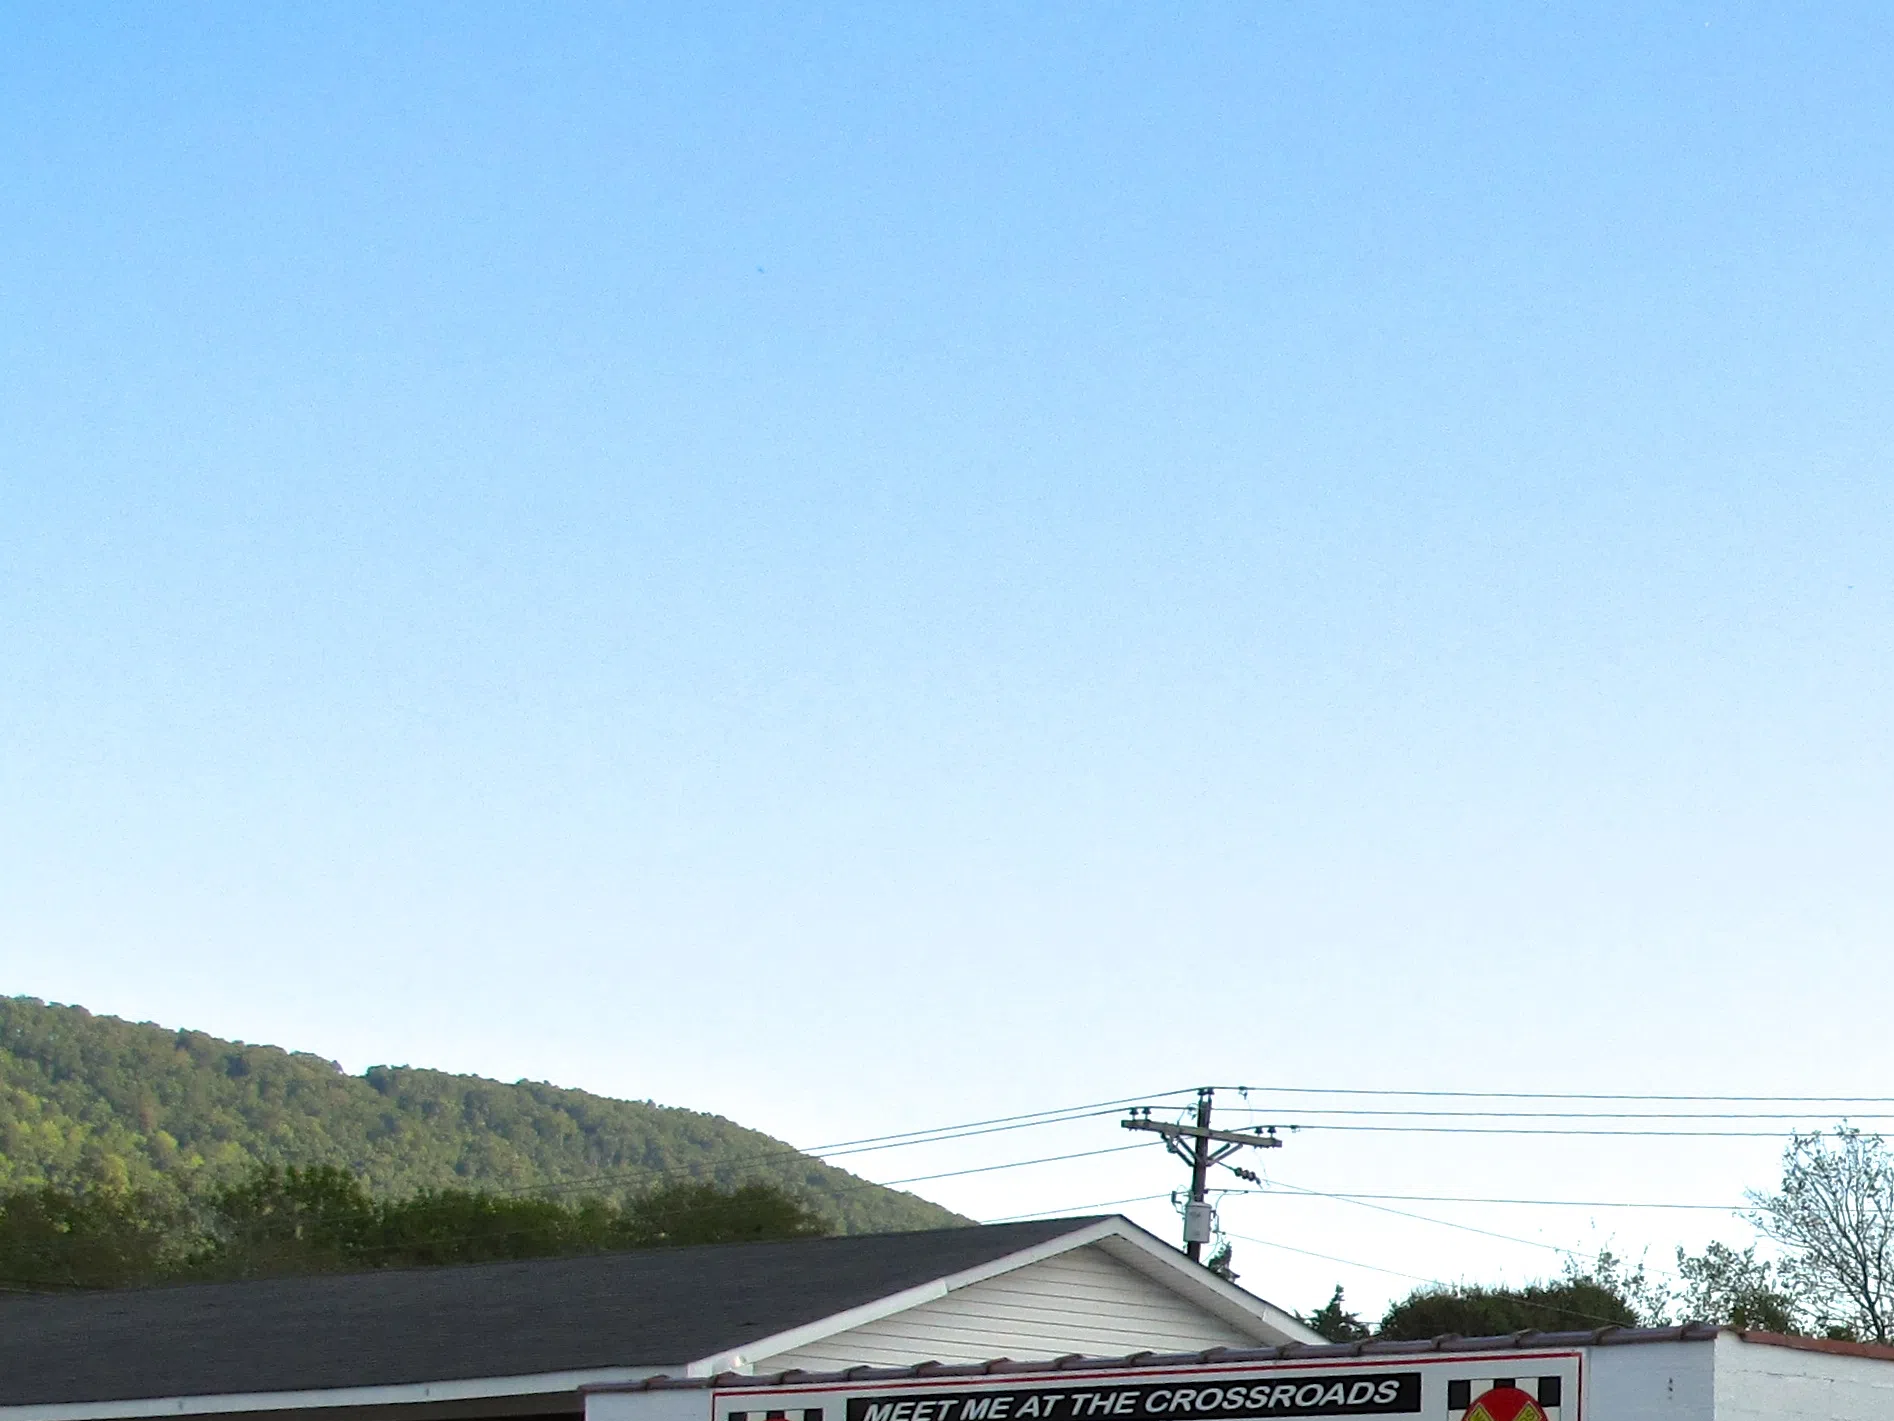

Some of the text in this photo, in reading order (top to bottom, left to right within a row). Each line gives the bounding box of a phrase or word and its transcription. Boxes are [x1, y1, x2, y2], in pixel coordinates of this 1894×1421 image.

[959, 1396, 1015, 1421] ME
[1014, 1394, 1063, 1418] AT
[1071, 1391, 1141, 1416] THE
[1145, 1380, 1400, 1413] CROSSROADS
